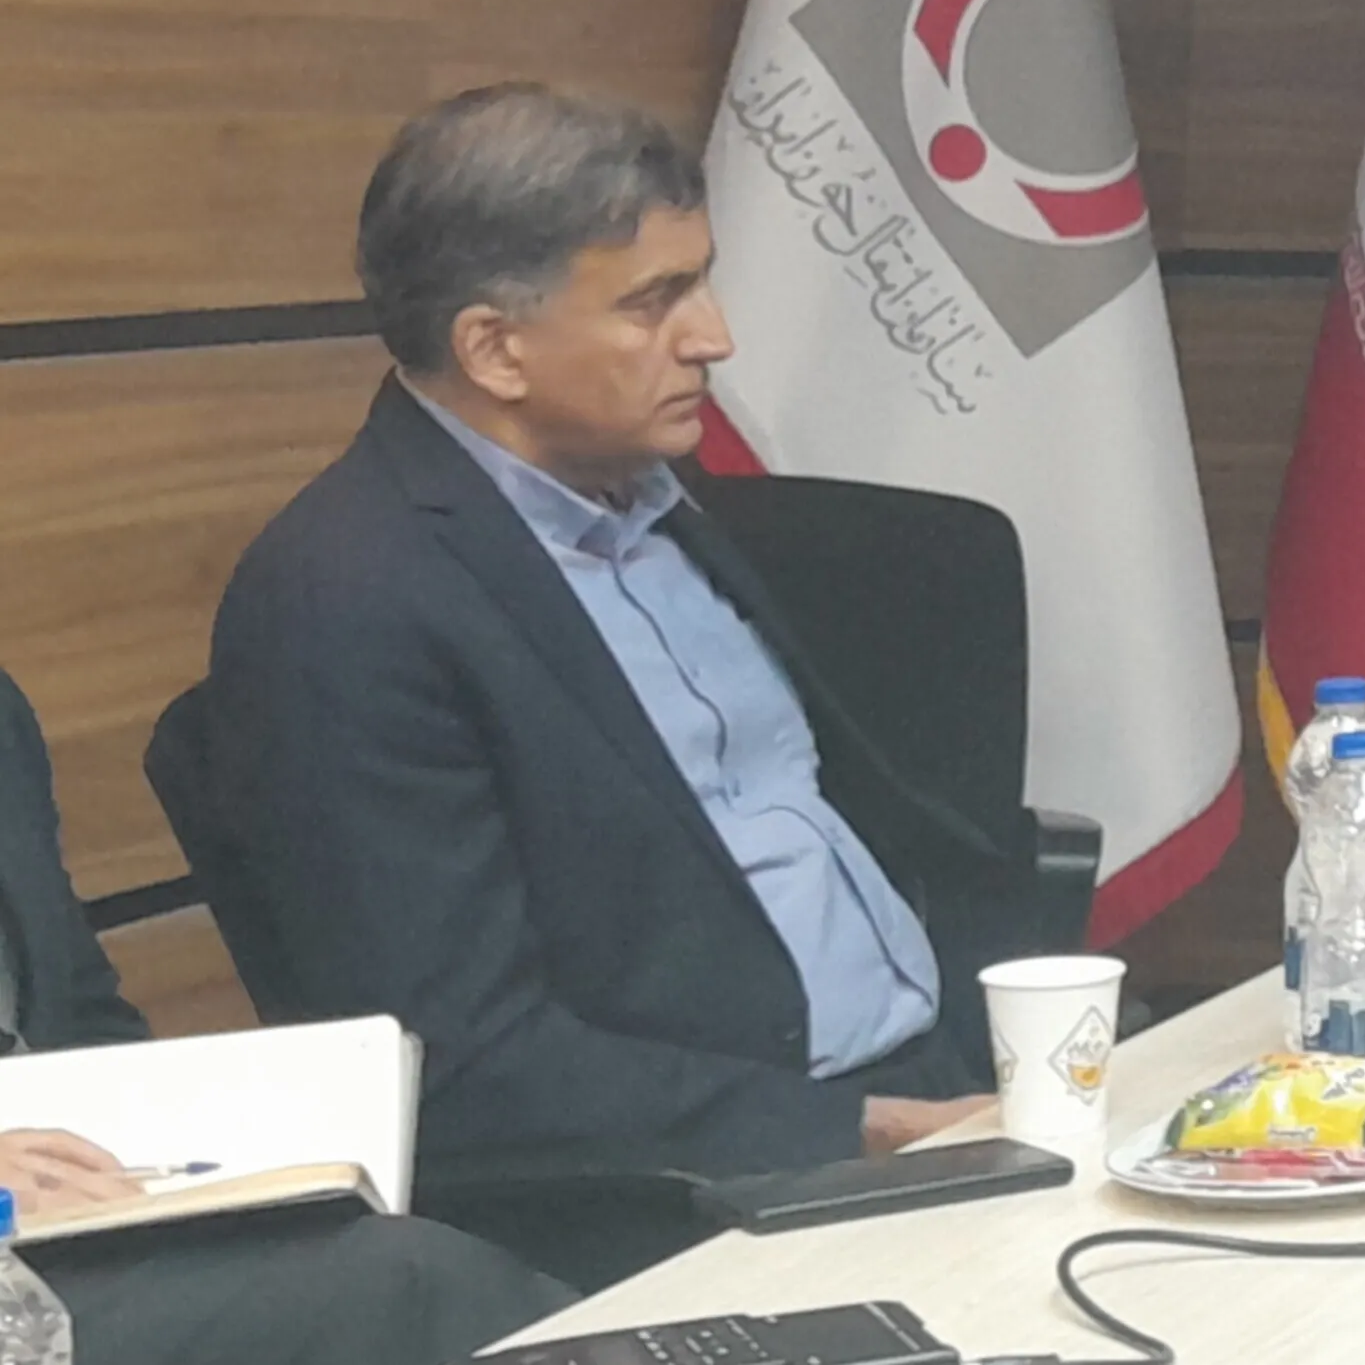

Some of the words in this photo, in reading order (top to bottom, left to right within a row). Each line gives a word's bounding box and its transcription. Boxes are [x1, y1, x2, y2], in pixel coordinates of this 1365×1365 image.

[728, 77, 838, 154] ایران
[813, 213, 932, 306] انتقال
[872, 294, 984, 413] سازمان
